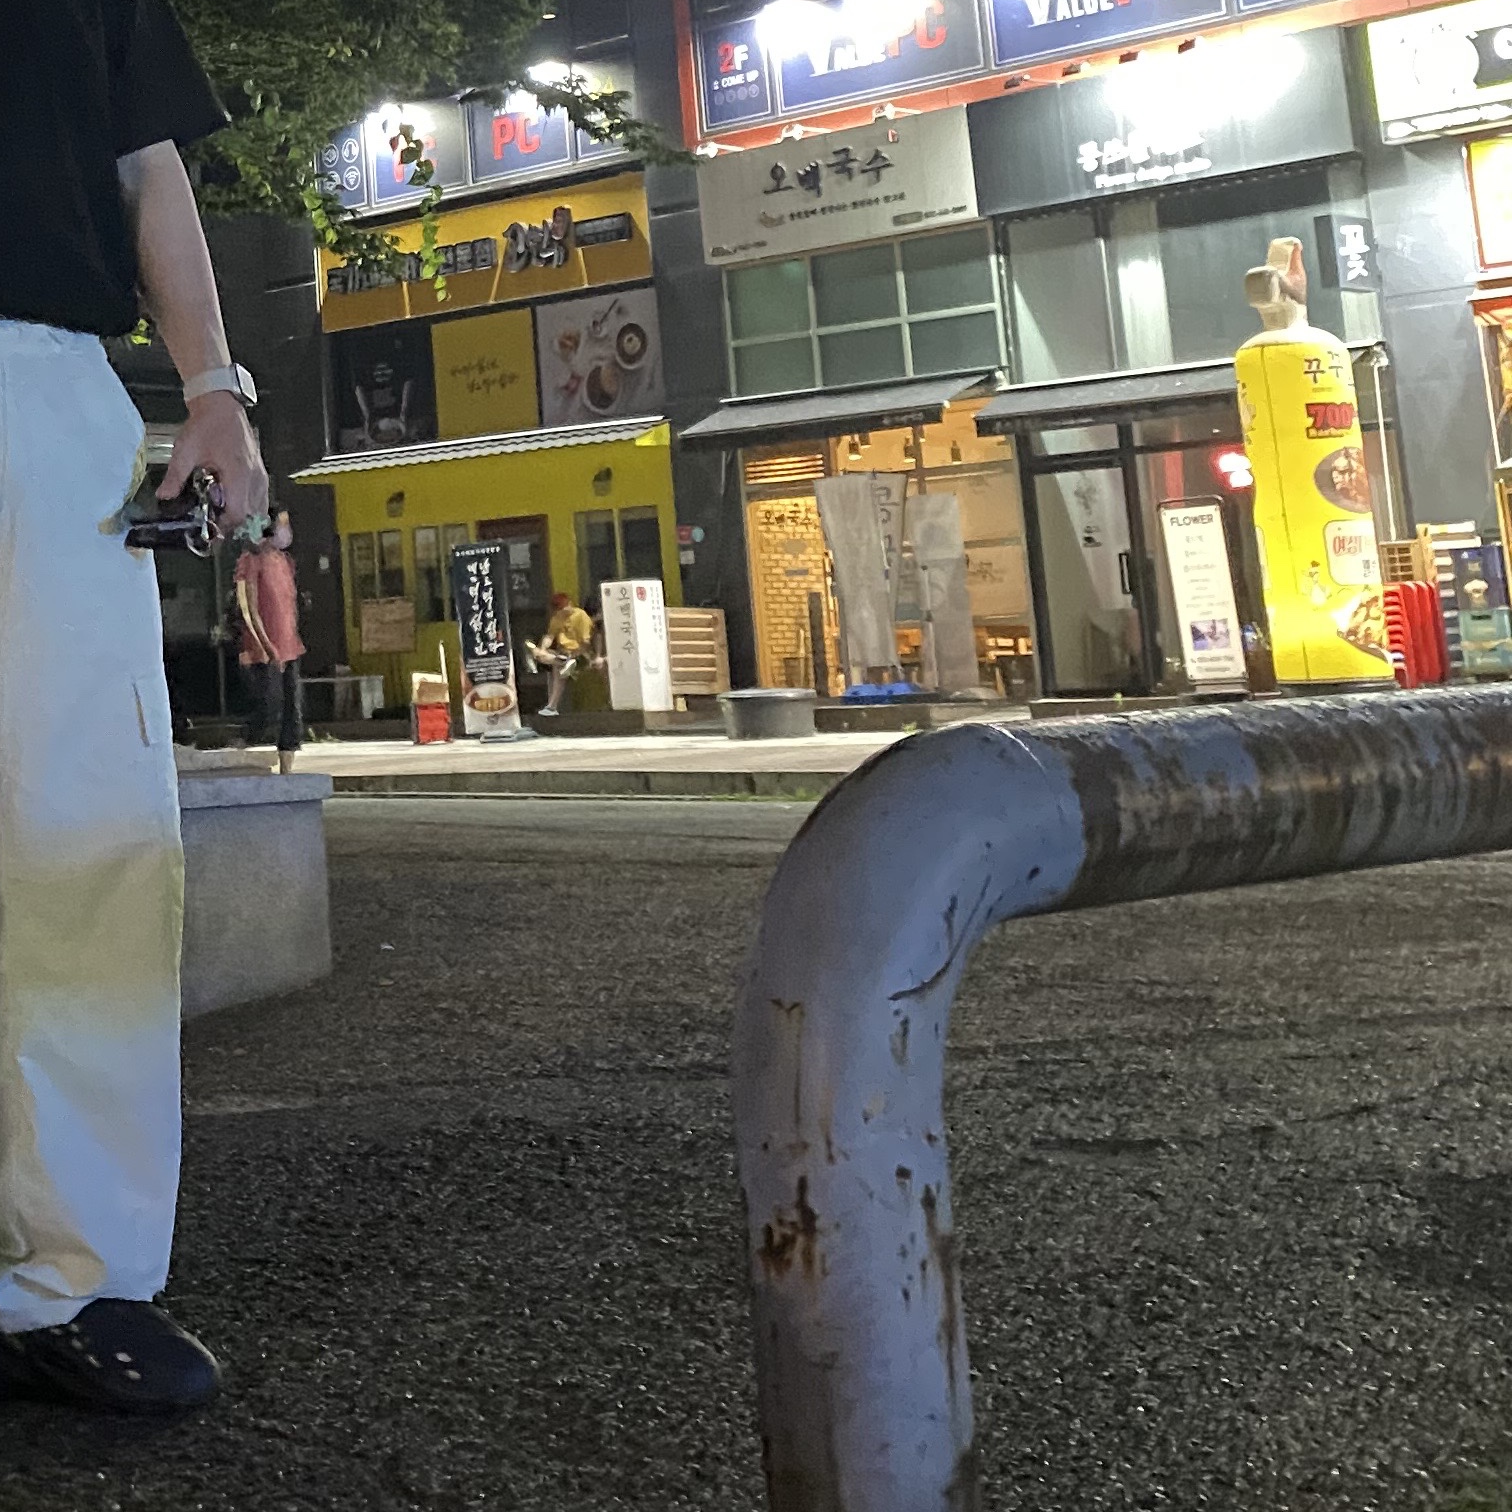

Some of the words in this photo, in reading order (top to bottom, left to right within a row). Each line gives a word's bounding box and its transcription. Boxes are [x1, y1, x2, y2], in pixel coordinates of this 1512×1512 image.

[717, 41, 749, 74] 2F
[492, 112, 541, 161] PC
[1169, 513, 1214, 527] FLOWER
